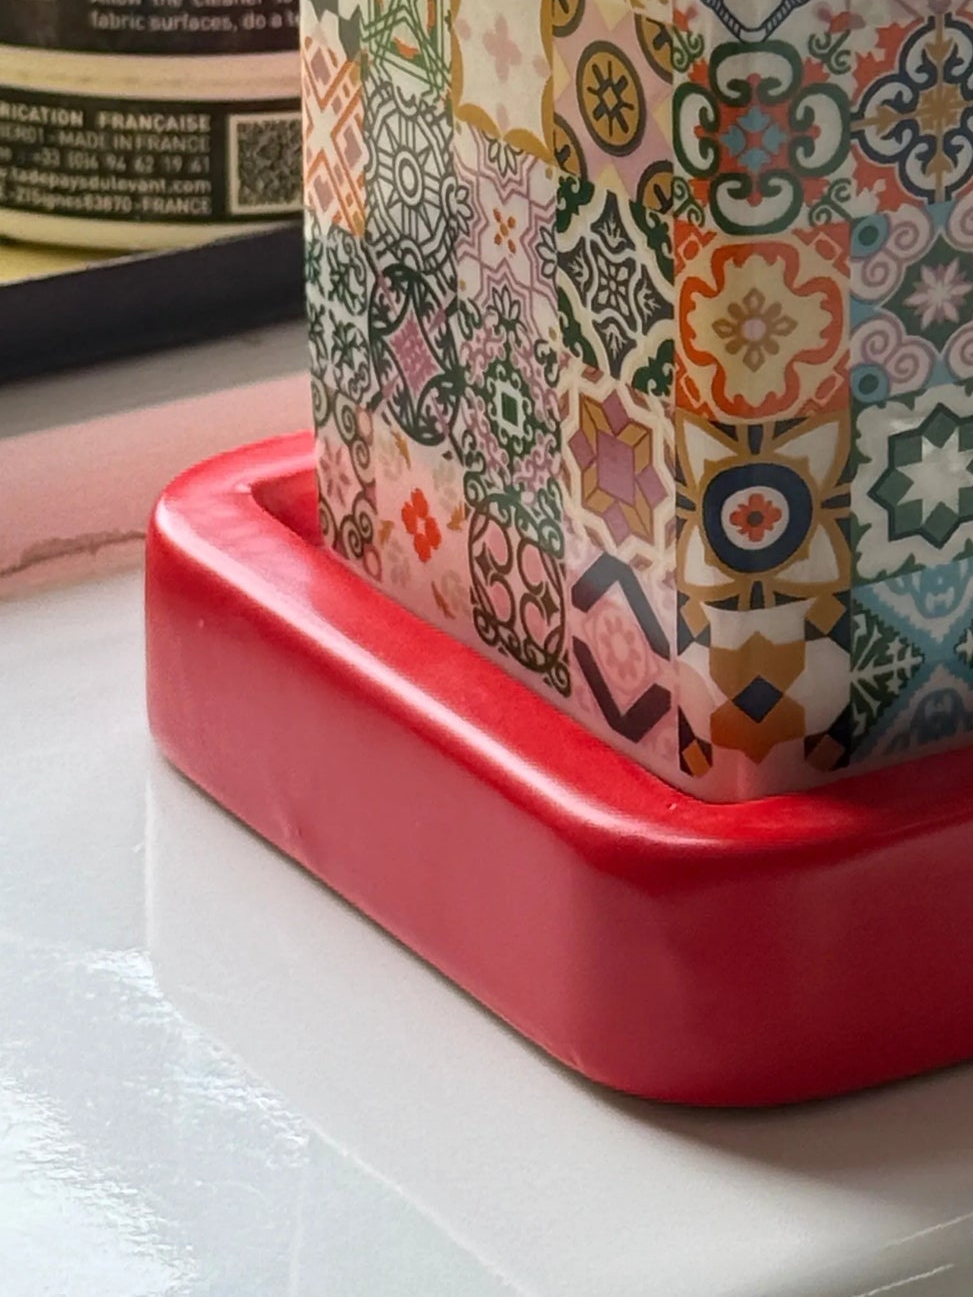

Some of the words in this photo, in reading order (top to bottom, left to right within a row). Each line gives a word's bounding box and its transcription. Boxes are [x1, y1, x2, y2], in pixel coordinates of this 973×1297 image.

[91, 8, 146, 32] fabric
[149, 12, 238, 34] surfaces,
[242, 11, 267, 30] do
[270, 13, 283, 30] a
[97, 110, 212, 134] FRANÇAISE
[59, 129, 110, 151] MADE
[113, 134, 132, 151] IN
[135, 134, 211, 154] FRANCE
